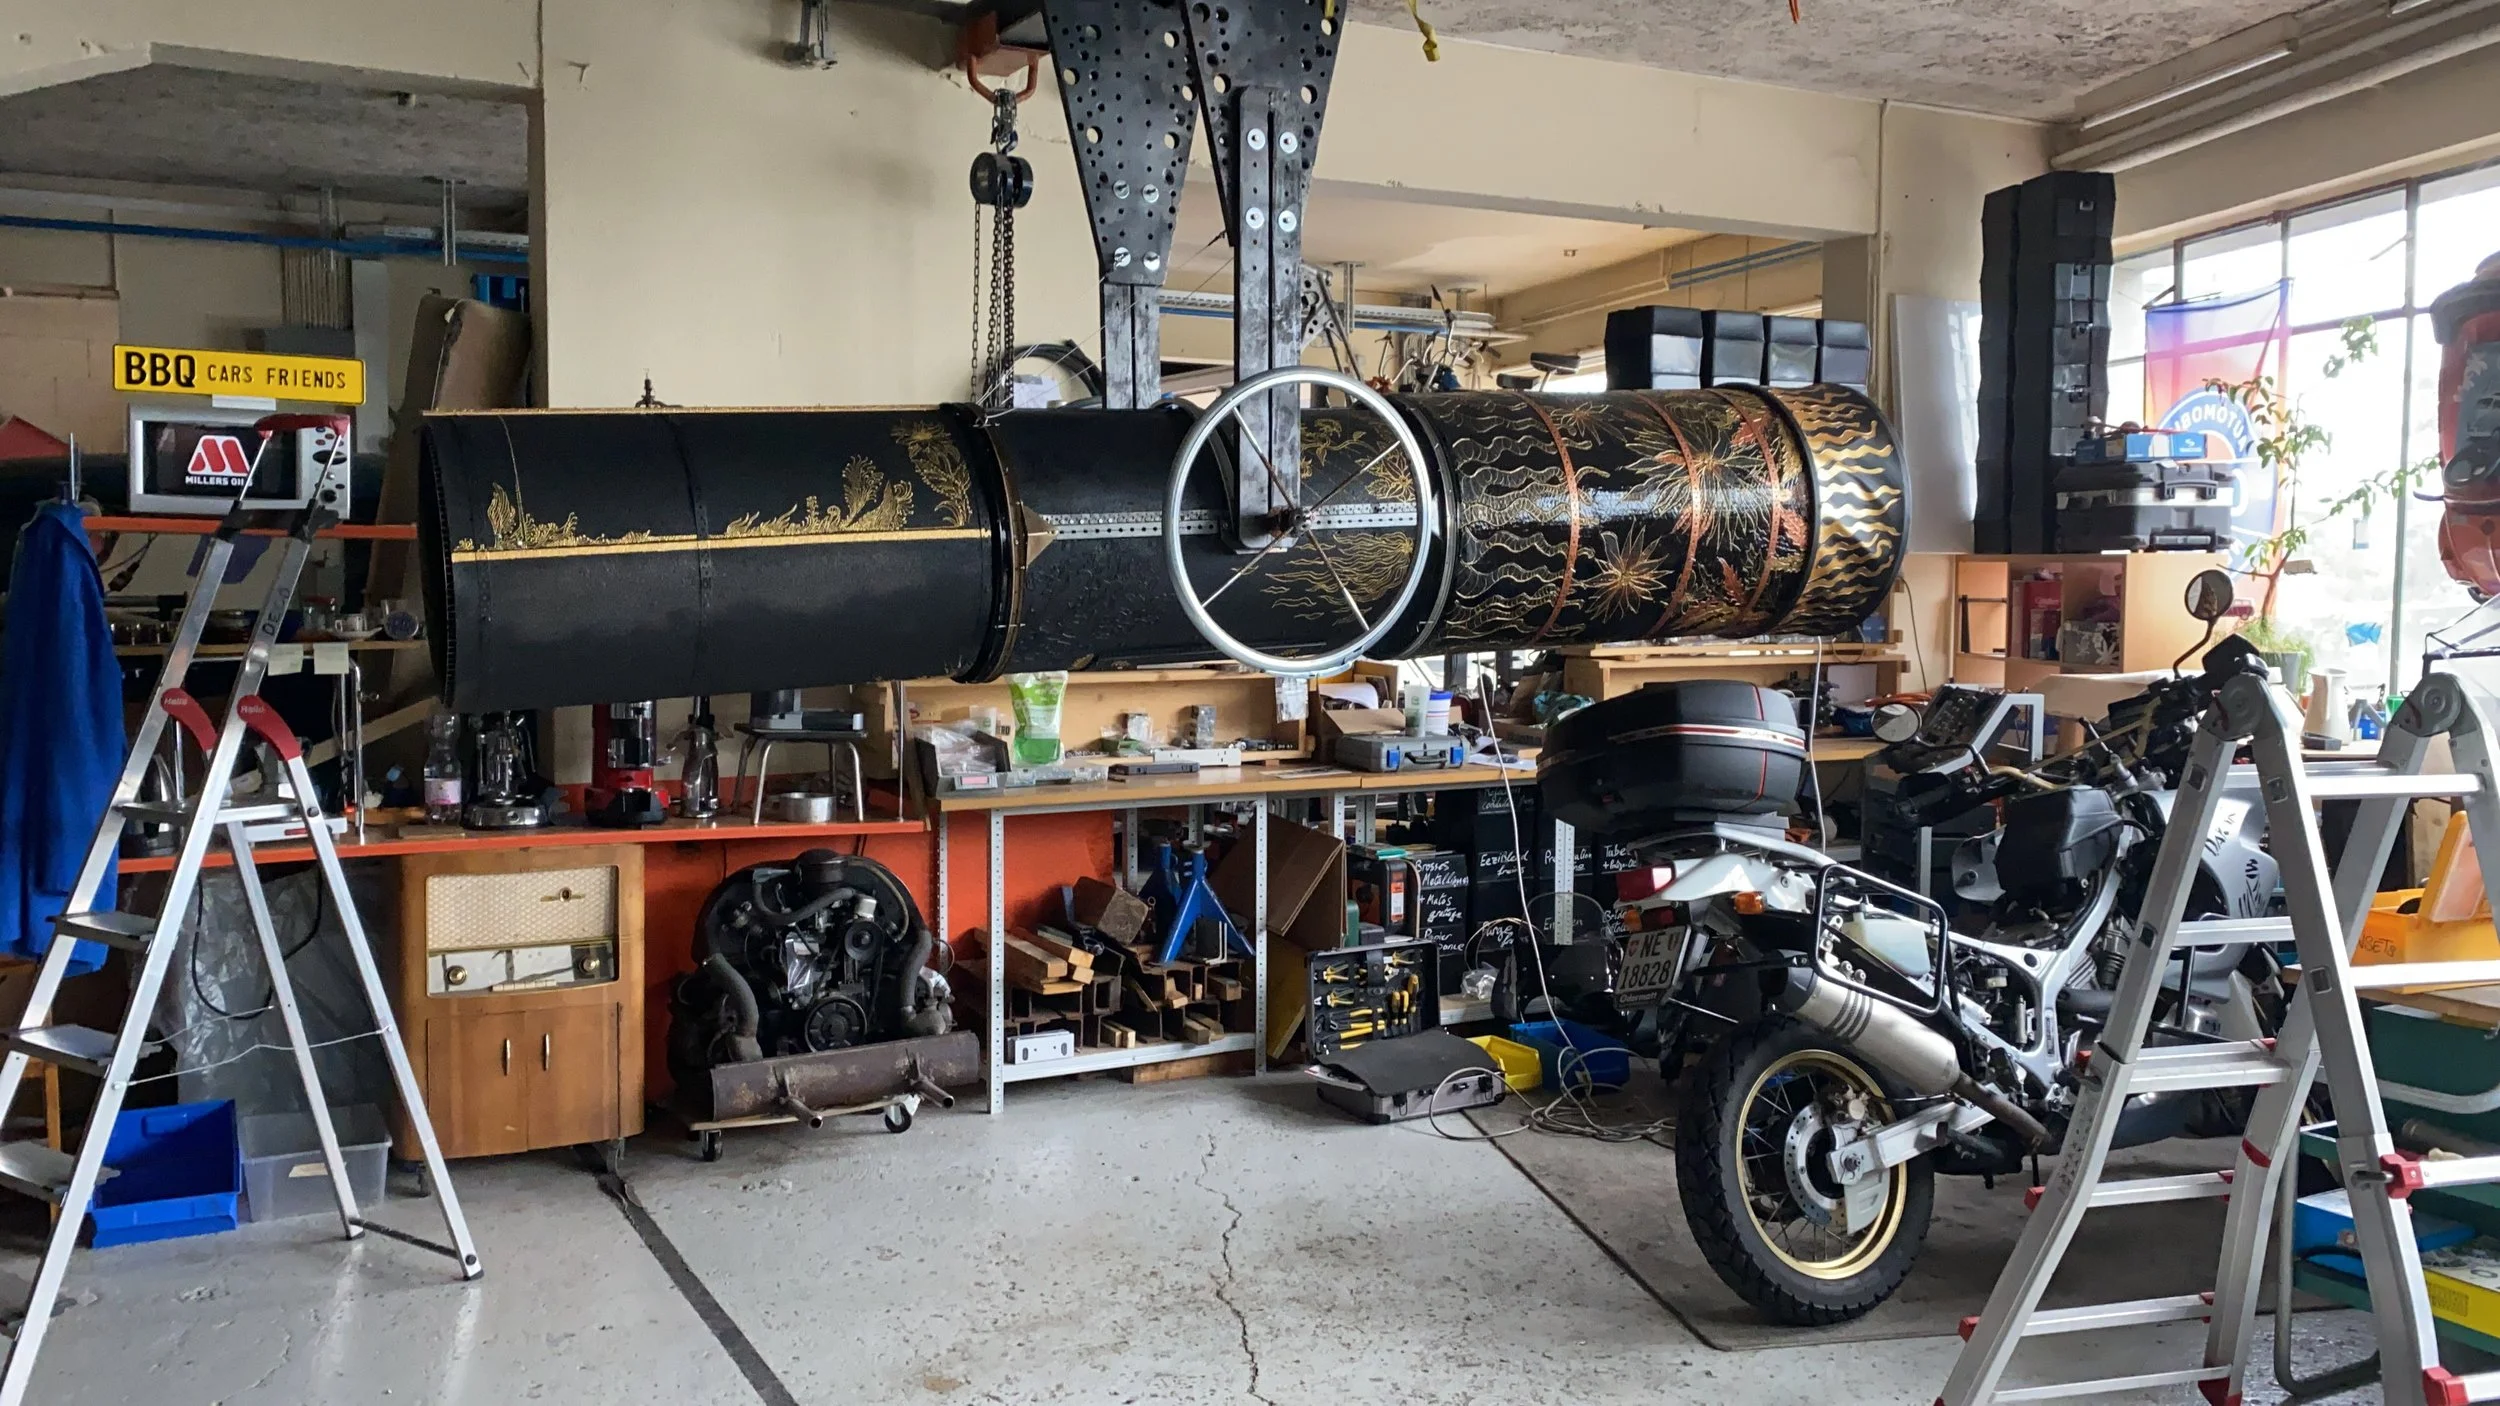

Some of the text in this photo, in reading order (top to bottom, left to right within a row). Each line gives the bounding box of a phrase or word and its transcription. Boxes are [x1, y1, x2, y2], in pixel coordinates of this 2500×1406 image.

[125, 351, 346, 389] BBQ CARS FRIENDS
[185, 476, 229, 486] MILLERS
[1640, 932, 1666, 959] NE
[1619, 960, 1672, 990] 18828
